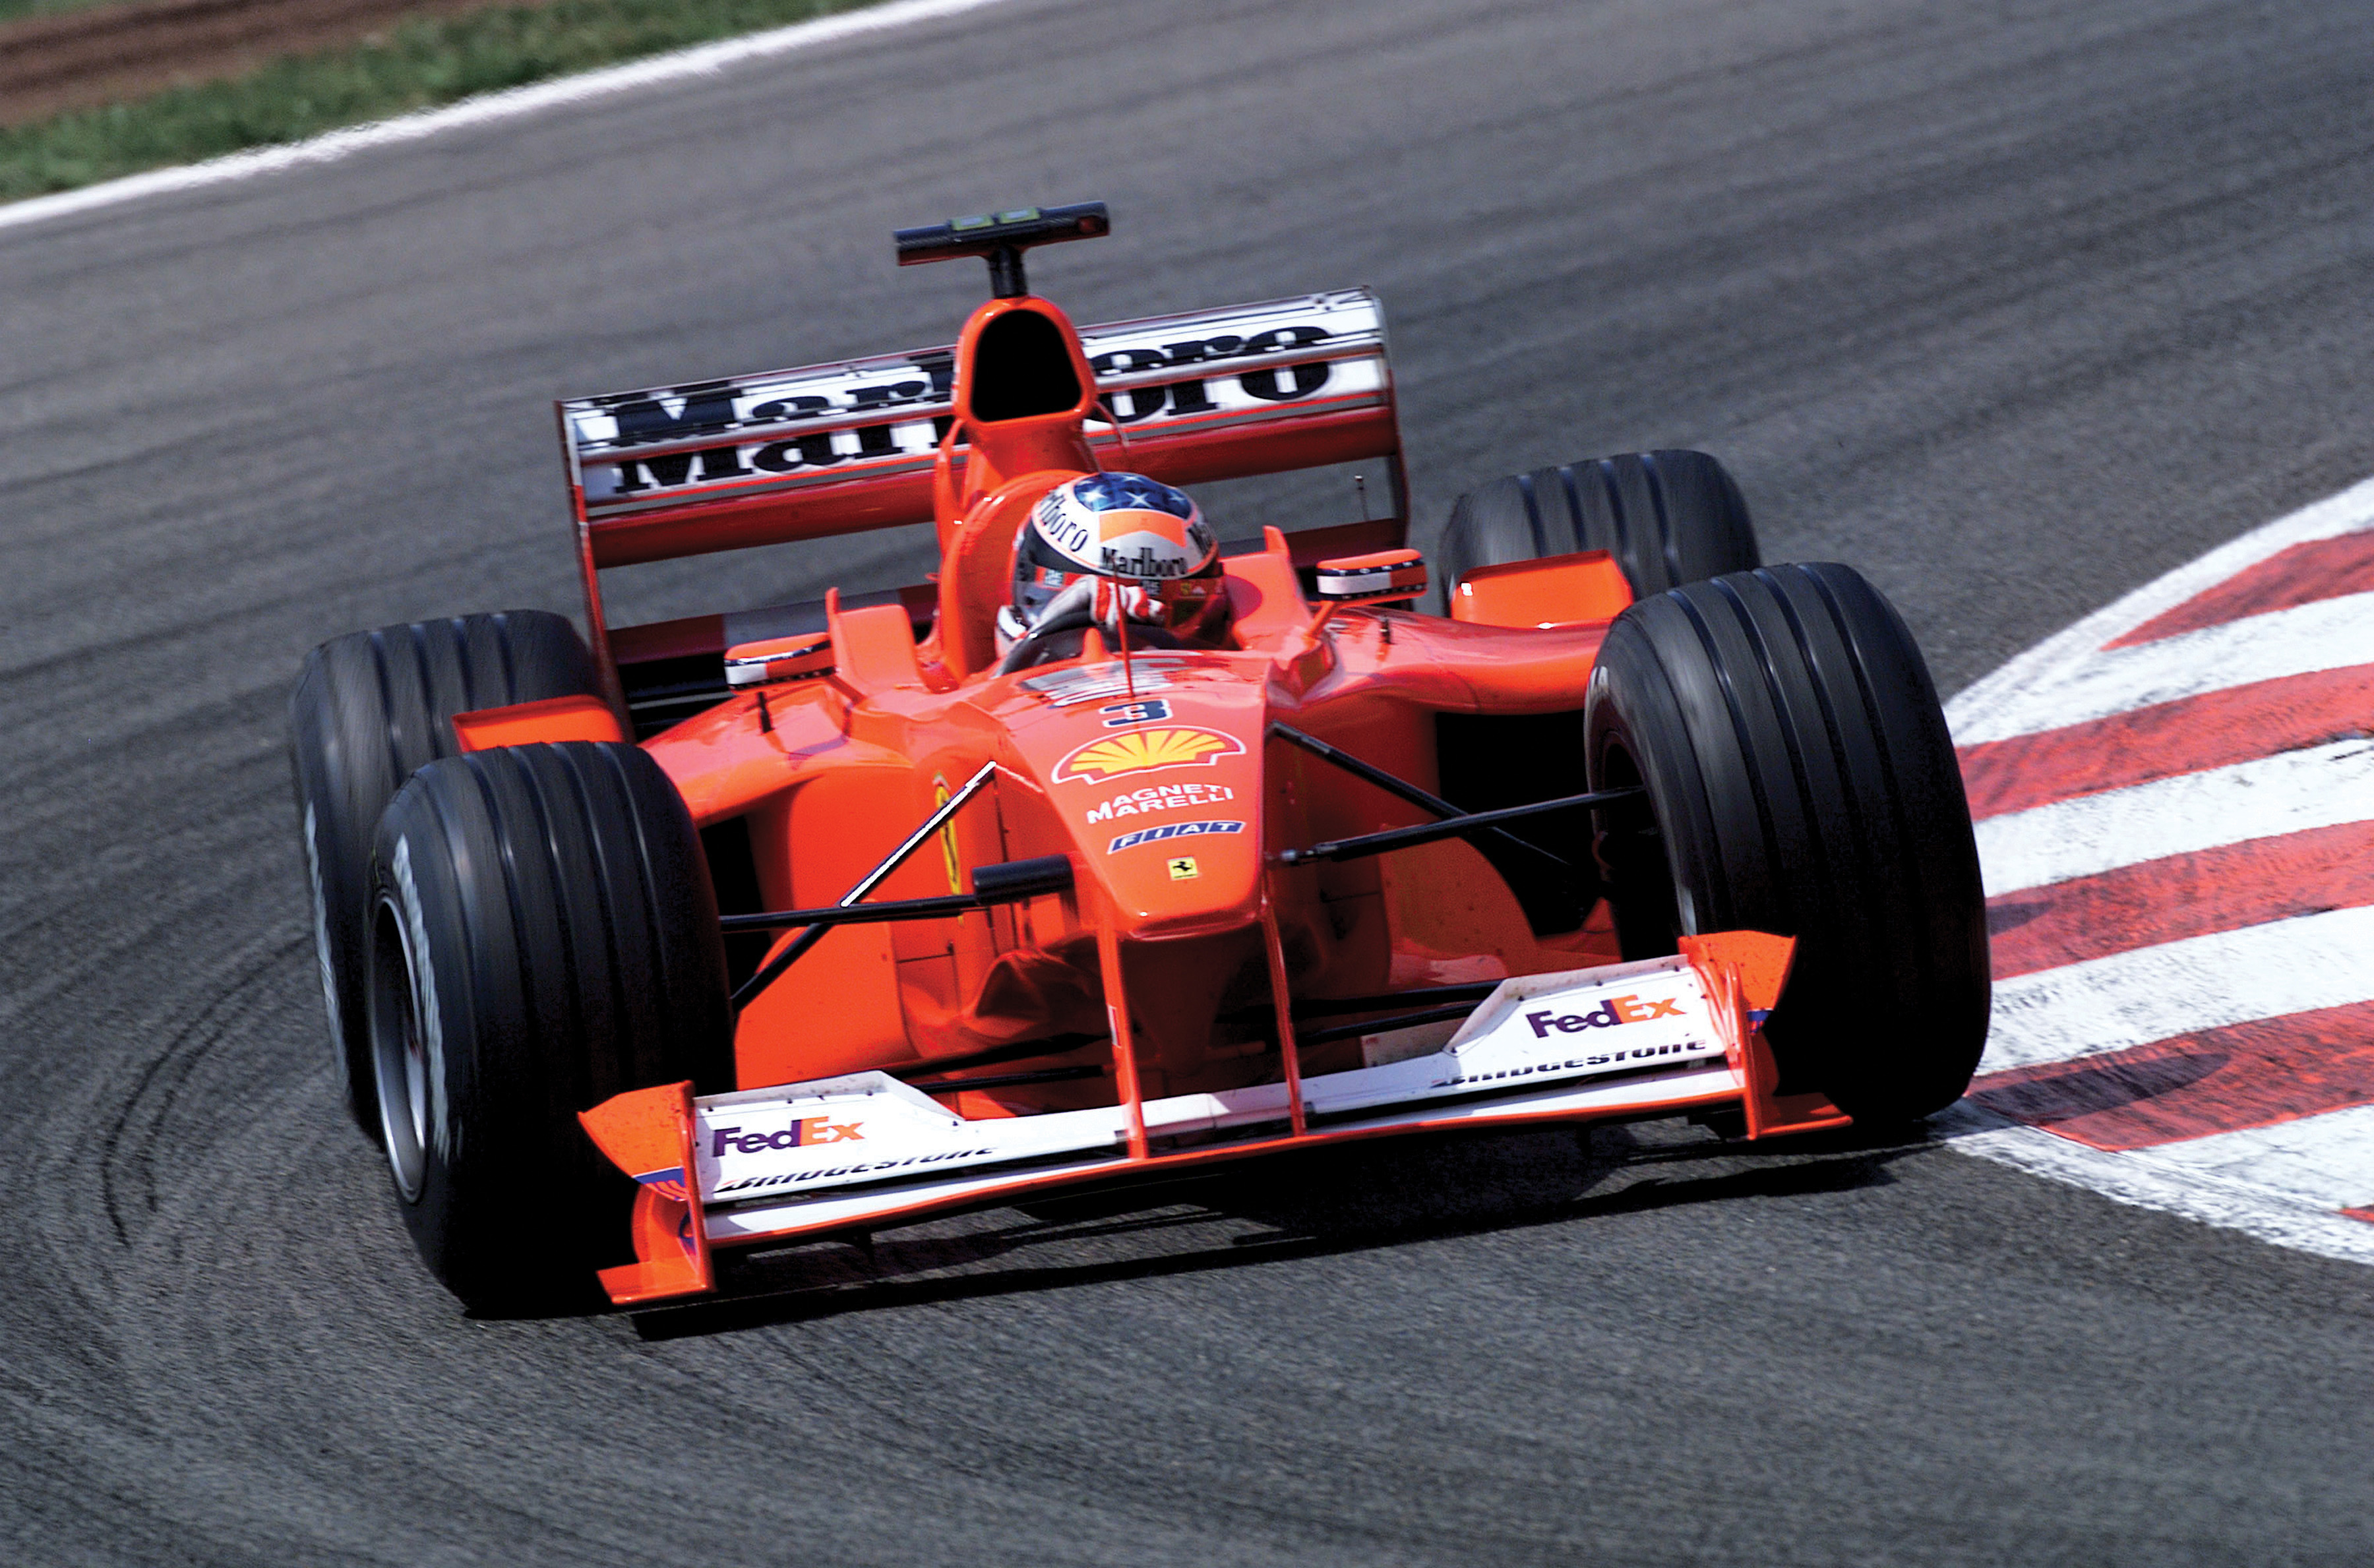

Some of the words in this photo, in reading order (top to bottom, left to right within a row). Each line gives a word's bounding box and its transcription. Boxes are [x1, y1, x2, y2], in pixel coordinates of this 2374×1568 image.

[1099, 699, 1173, 728] 3
[1119, 824, 1235, 847] FIAT
[1525, 994, 1687, 1038] FedEx
[713, 1116, 866, 1158] FedEx
